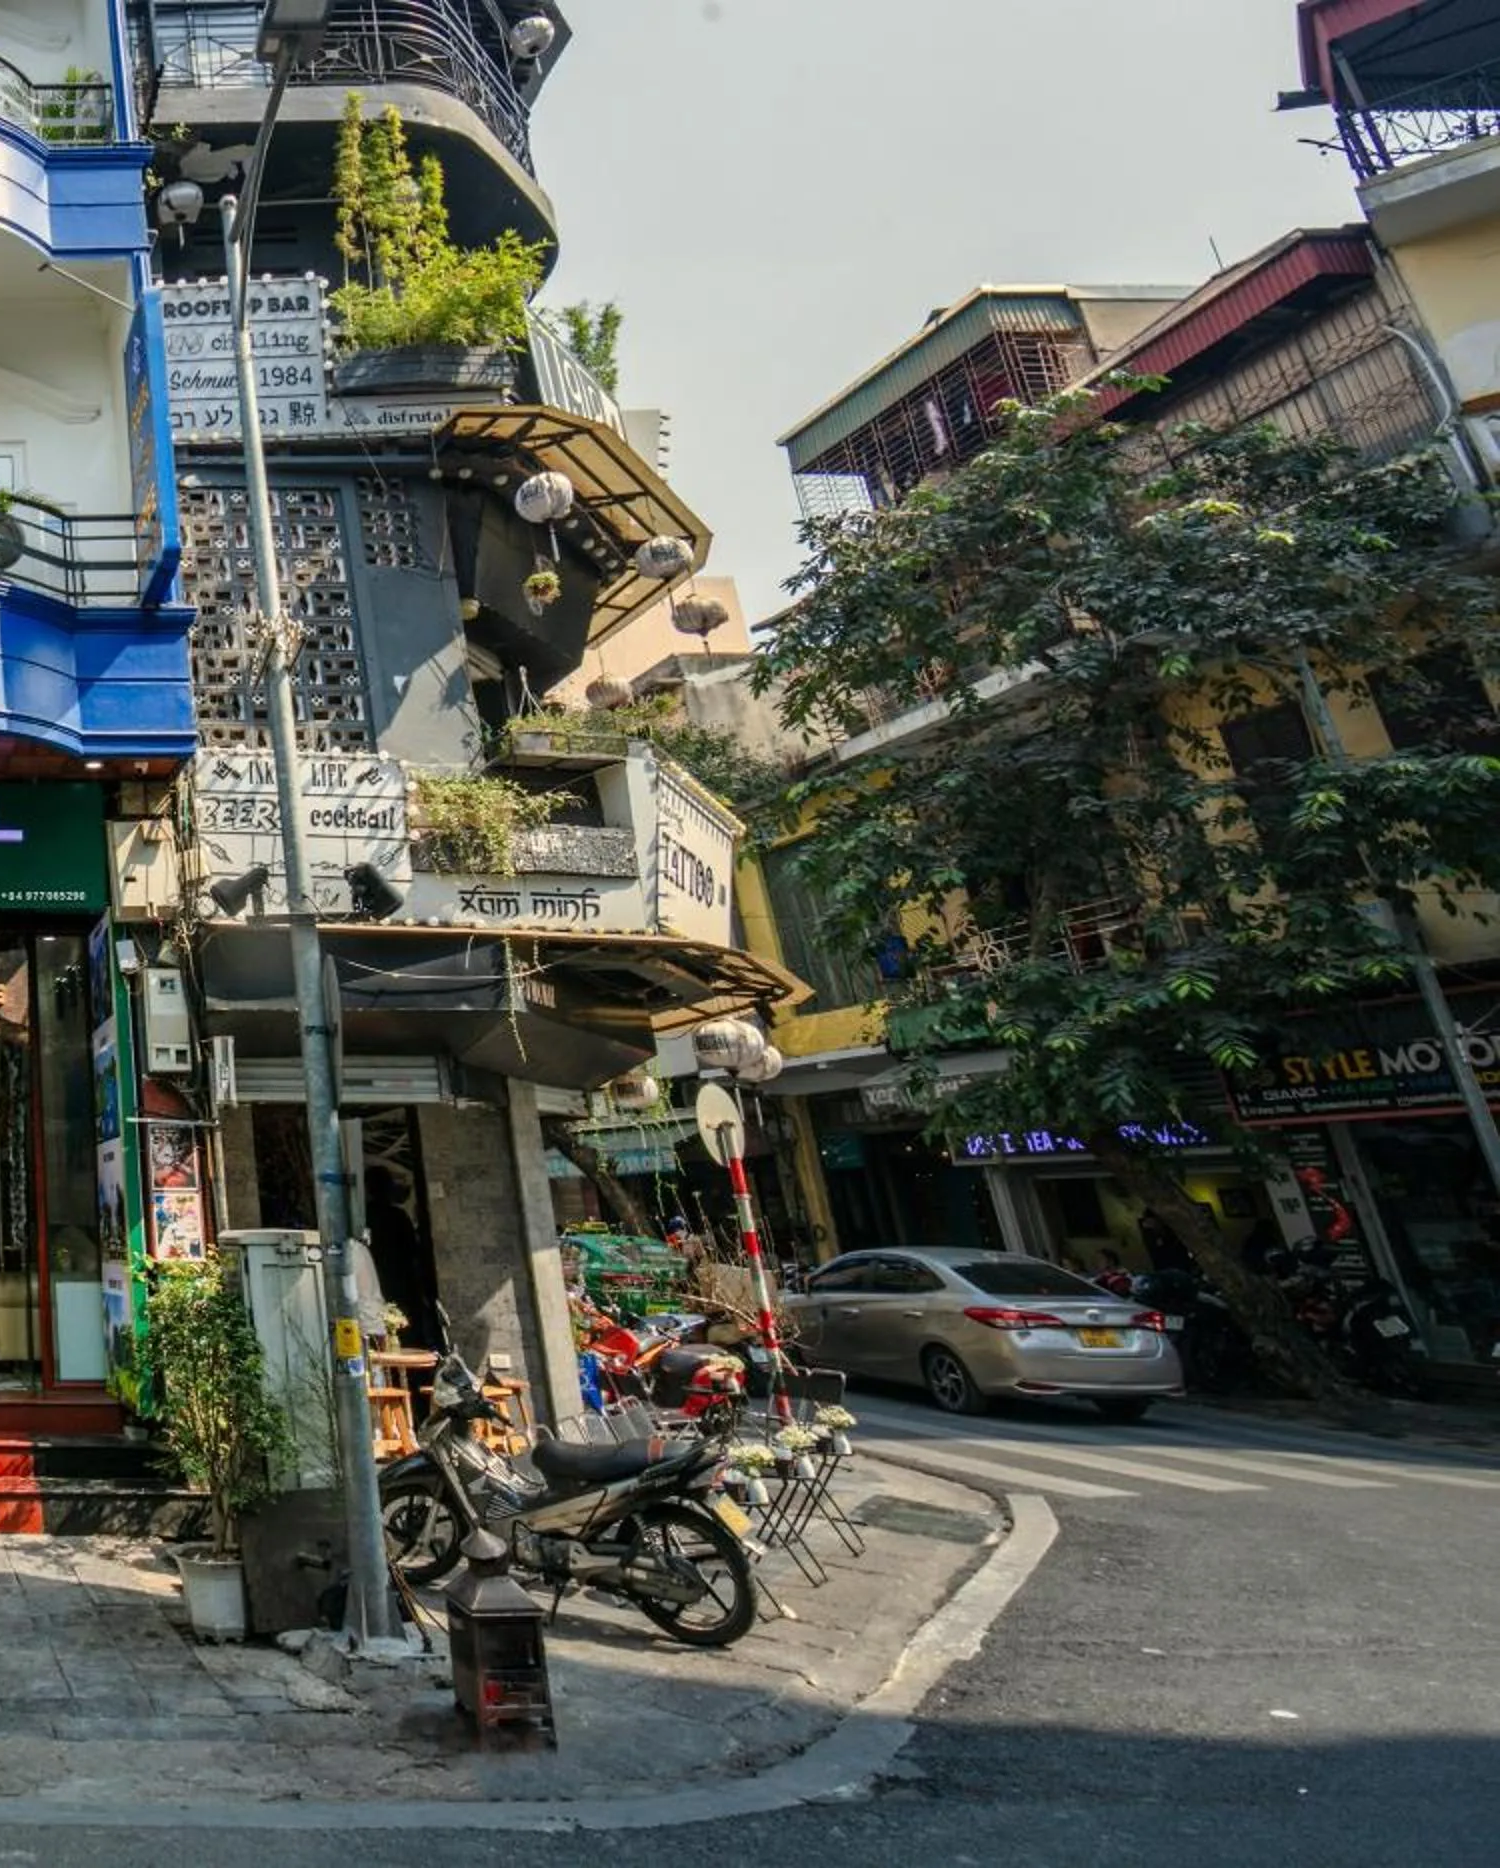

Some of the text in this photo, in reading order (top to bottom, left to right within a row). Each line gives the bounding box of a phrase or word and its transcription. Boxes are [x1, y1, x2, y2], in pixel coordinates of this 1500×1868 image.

[164, 296, 310, 318] ROOFTP BAR
[211, 335, 309, 352] chlling
[260, 366, 312, 387] 1984
[249, 760, 348, 788] INK LIFE
[310, 805, 396, 830] cocktail
